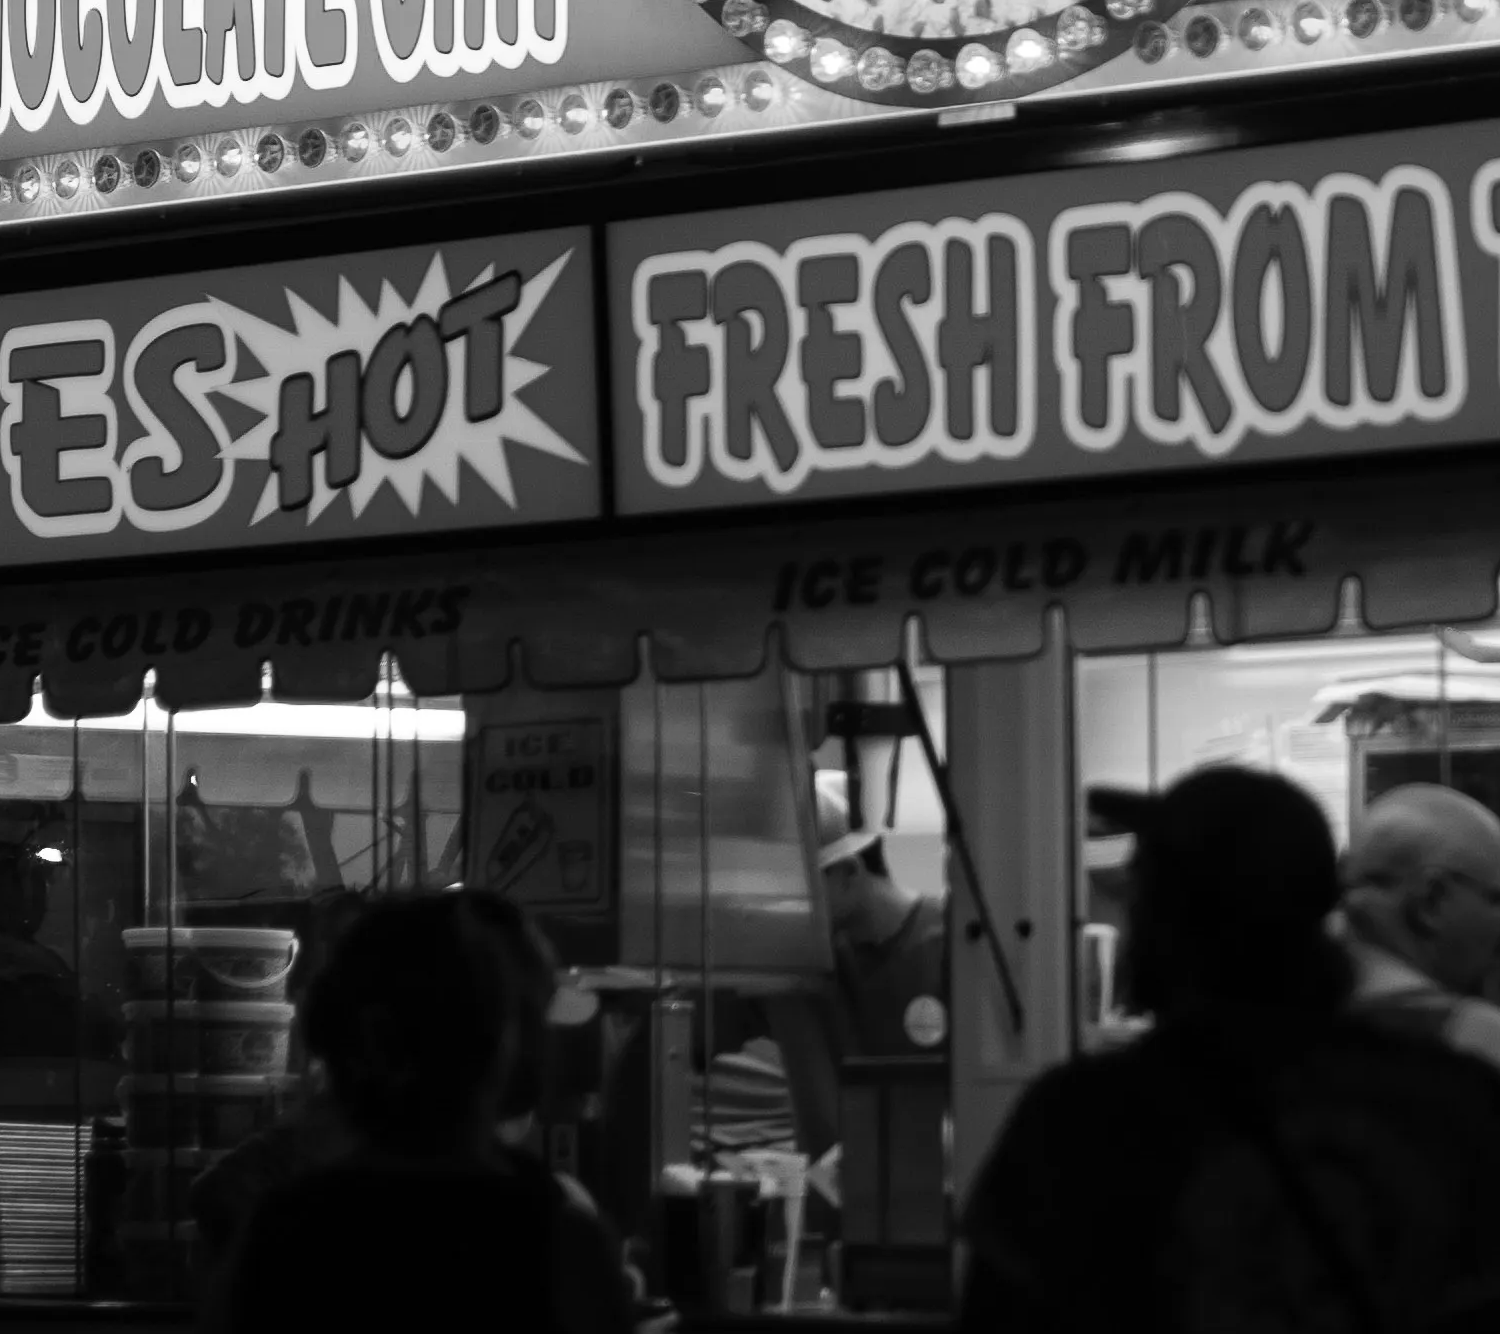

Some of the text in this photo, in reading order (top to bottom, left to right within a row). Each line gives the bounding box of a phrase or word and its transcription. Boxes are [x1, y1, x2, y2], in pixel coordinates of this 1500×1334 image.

[631, 213, 1033, 496] FRESH
[1050, 164, 1468, 457] FROM
[268, 271, 522, 513] HOT
[771, 518, 1318, 615] ICE COLD MILK
[65, 607, 212, 663] COLD
[233, 584, 472, 649] DRINKS
[485, 765, 593, 794] COLD
[505, 729, 575, 757] ICE
